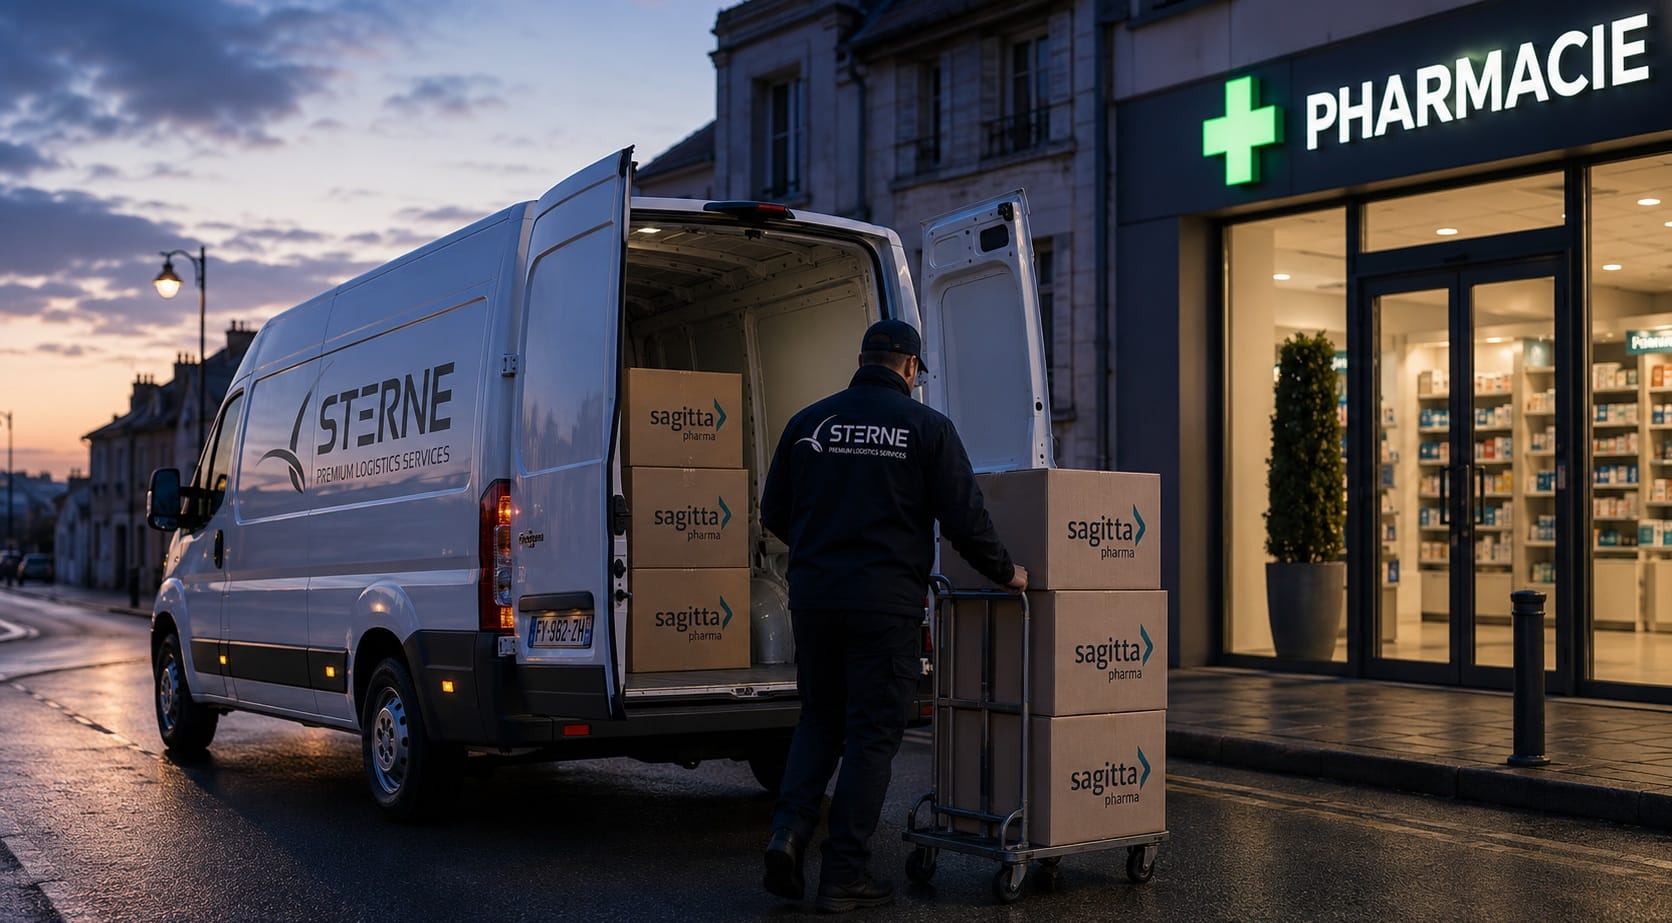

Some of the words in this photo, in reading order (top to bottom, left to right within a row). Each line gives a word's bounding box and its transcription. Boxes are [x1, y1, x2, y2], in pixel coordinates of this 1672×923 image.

[1306, 13, 1649, 150] PHARMACIE
[317, 361, 455, 455] STERNE
[650, 406, 714, 431] sagitta
[683, 431, 716, 441] pharma
[829, 424, 910, 448] STERNE
[317, 463, 354, 484] PREMIUM
[356, 455, 401, 478] LOGISTICS
[403, 445, 450, 470] SERVICES
[828, 446, 853, 454] PREMIUM
[853, 448, 879, 456] LOGISTICS
[879, 450, 907, 460] SERVICES
[654, 505, 719, 531] sagitta
[687, 531, 721, 542] pharma
[1067, 515, 1133, 547] sagitta
[1101, 545, 1135, 560] pharma
[655, 606, 720, 632] sagitta
[688, 631, 722, 643] pharma
[1075, 636, 1141, 670] sagitta
[1108, 667, 1143, 683] pharma
[1070, 761, 1138, 796] sagitta
[1105, 791, 1140, 808] pharma
